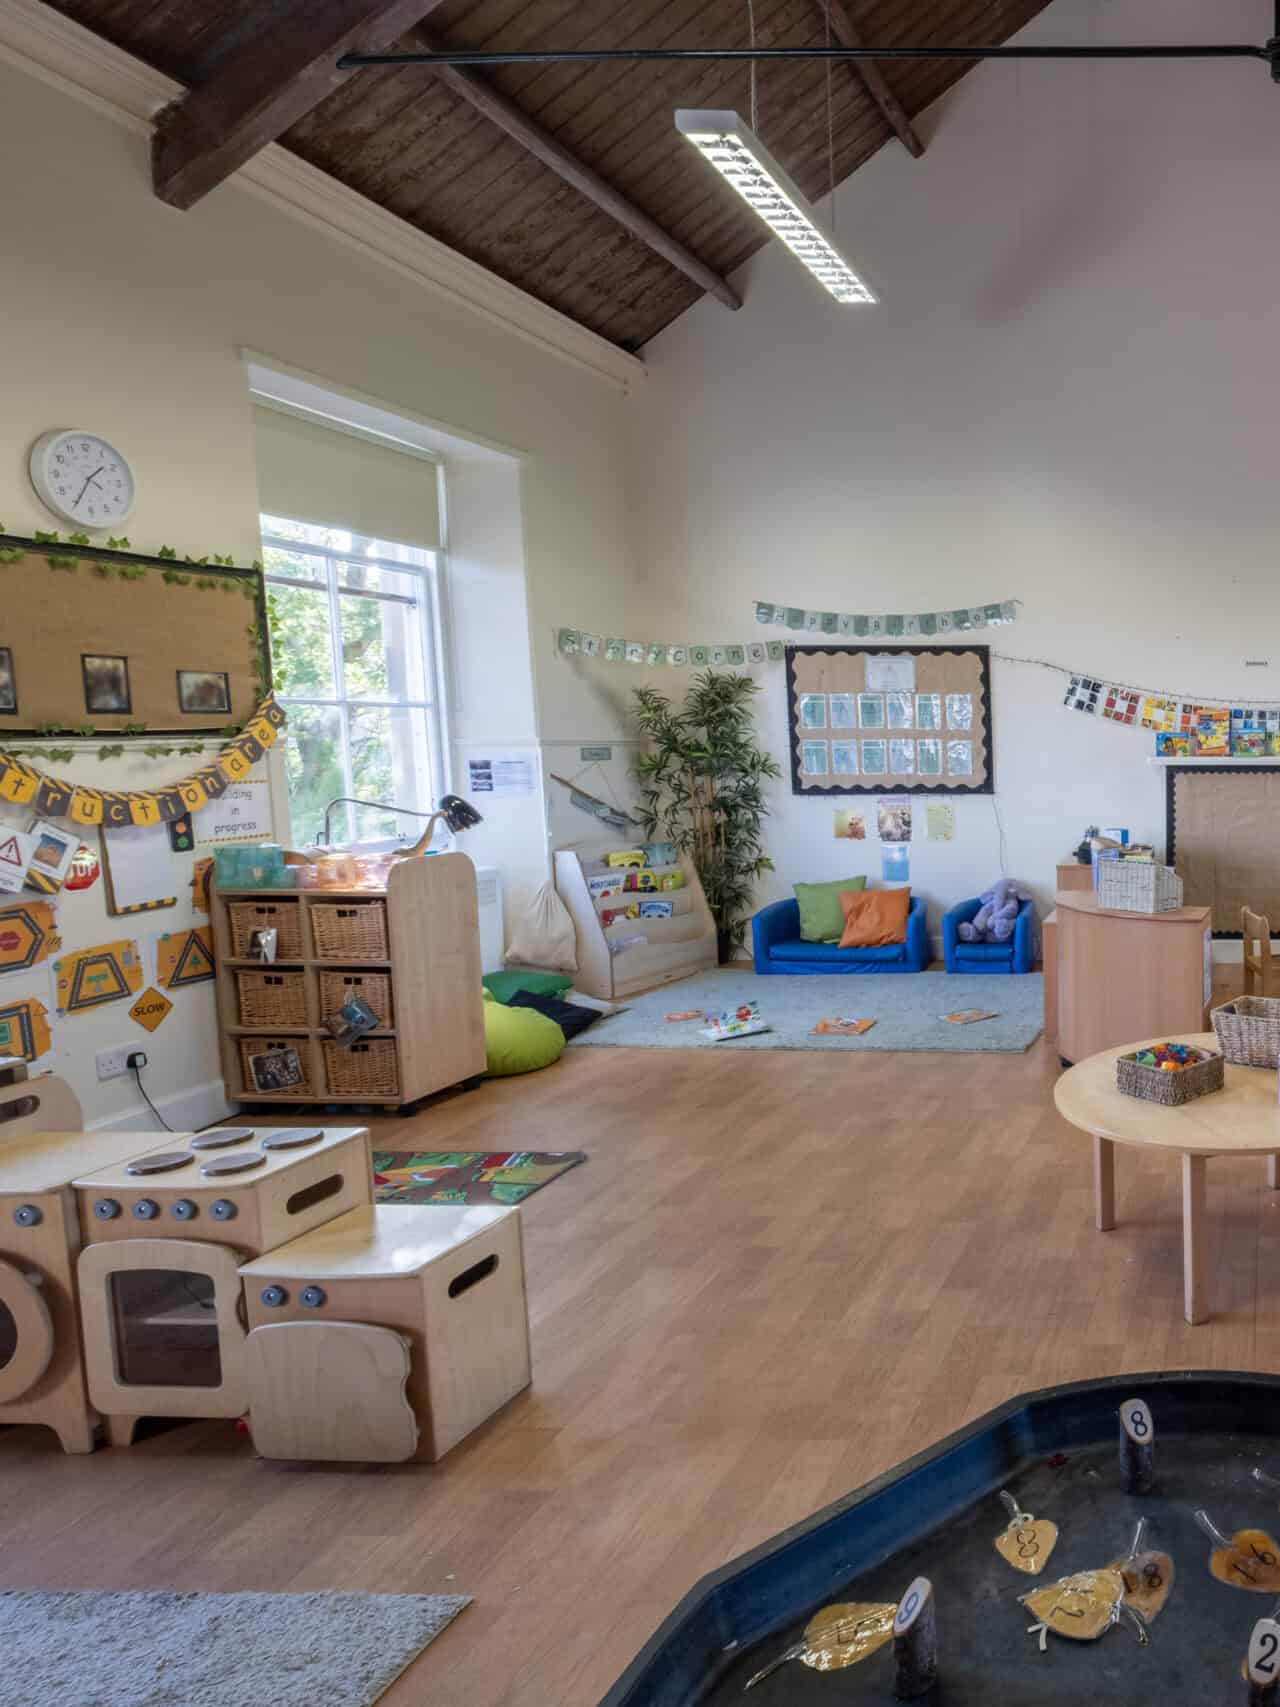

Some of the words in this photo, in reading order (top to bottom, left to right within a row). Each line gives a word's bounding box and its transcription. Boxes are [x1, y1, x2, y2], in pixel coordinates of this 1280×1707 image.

[214, 821, 257, 834] progress
[133, 1002, 165, 1017] SLOW
[1130, 1410, 1148, 1437] 8
[1254, 1633, 1279, 1674] 2
